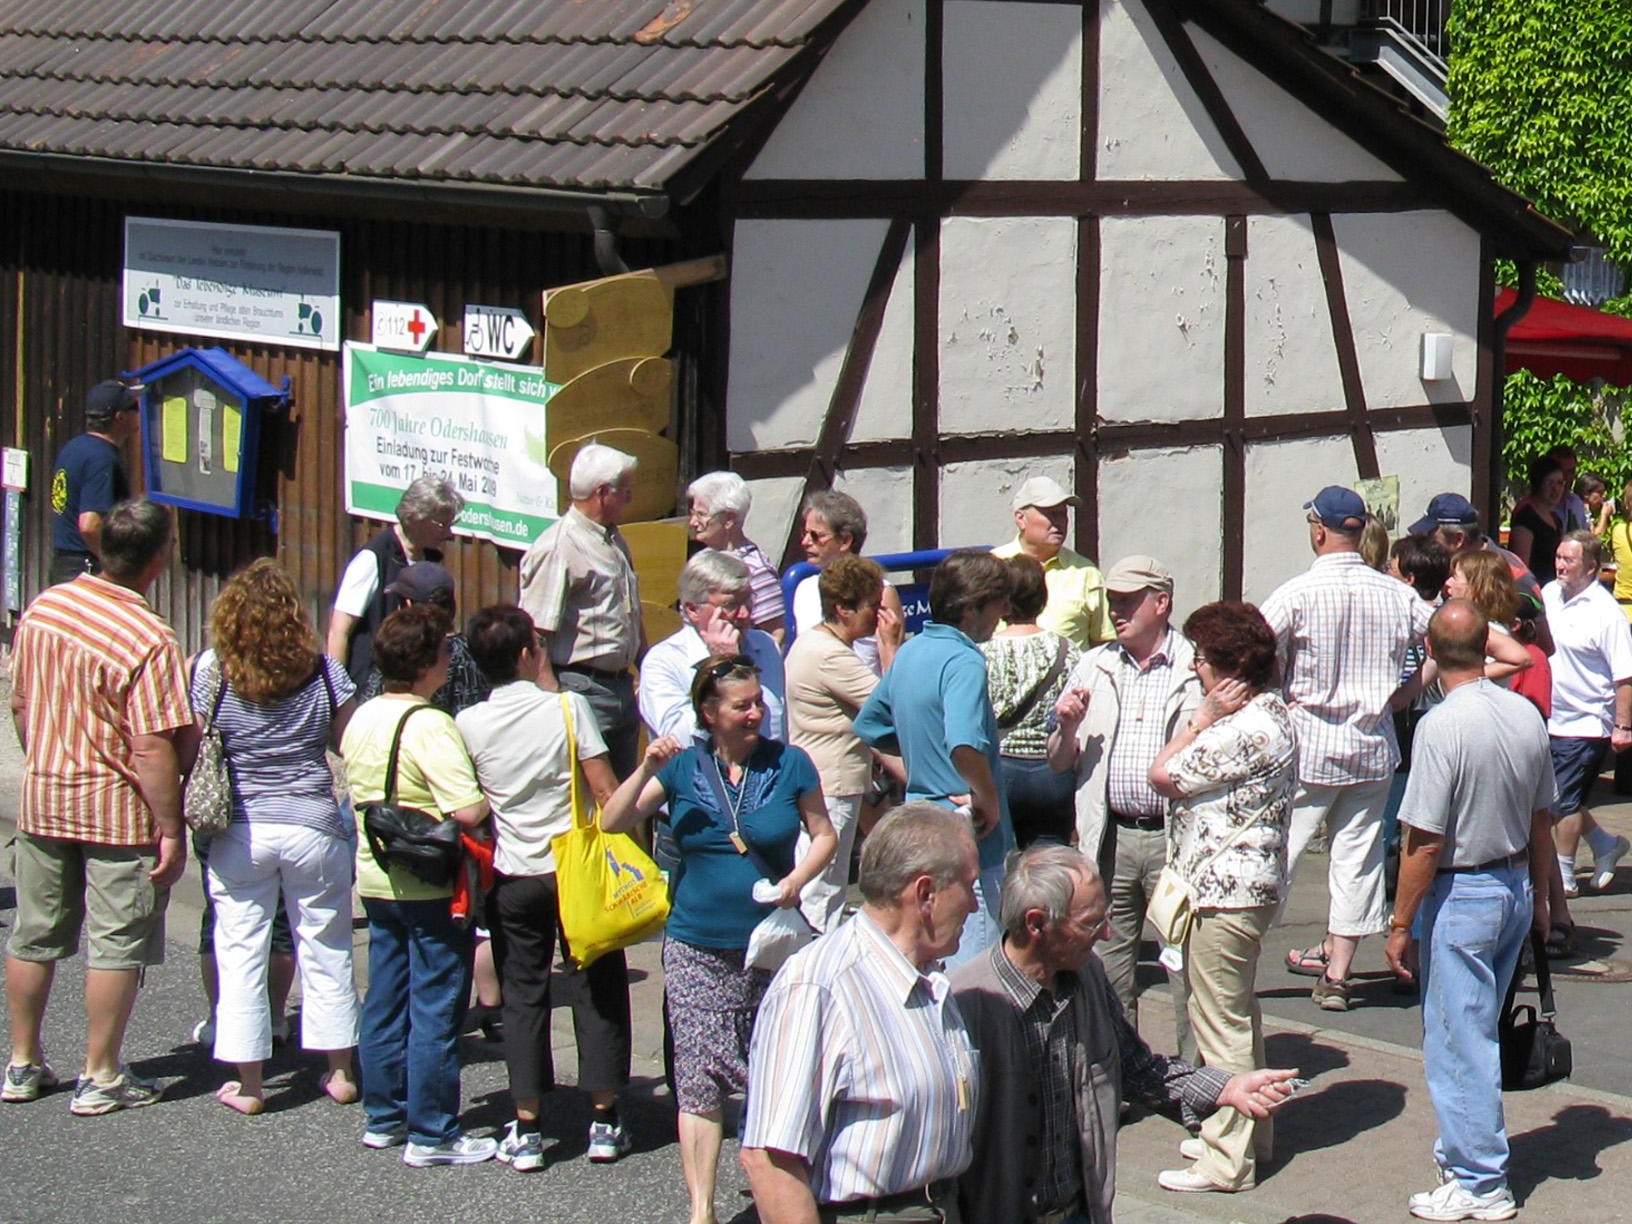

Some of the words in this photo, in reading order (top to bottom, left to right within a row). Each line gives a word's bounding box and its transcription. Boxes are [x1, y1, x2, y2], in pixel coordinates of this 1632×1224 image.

[387, 315, 405, 336] 112
[487, 314, 515, 354] WC
[368, 373, 384, 393] Ein
[387, 368, 454, 390] lebendiges
[457, 367, 486, 386] Dorf
[483, 373, 516, 393] stellt
[519, 377, 546, 398] sich
[369, 407, 391, 429] 700
[393, 410, 427, 435] Jahre
[377, 436, 428, 466] Einladung
[430, 448, 448, 464] zur
[379, 462, 401, 479] vom
[458, 471, 478, 493] Mai
